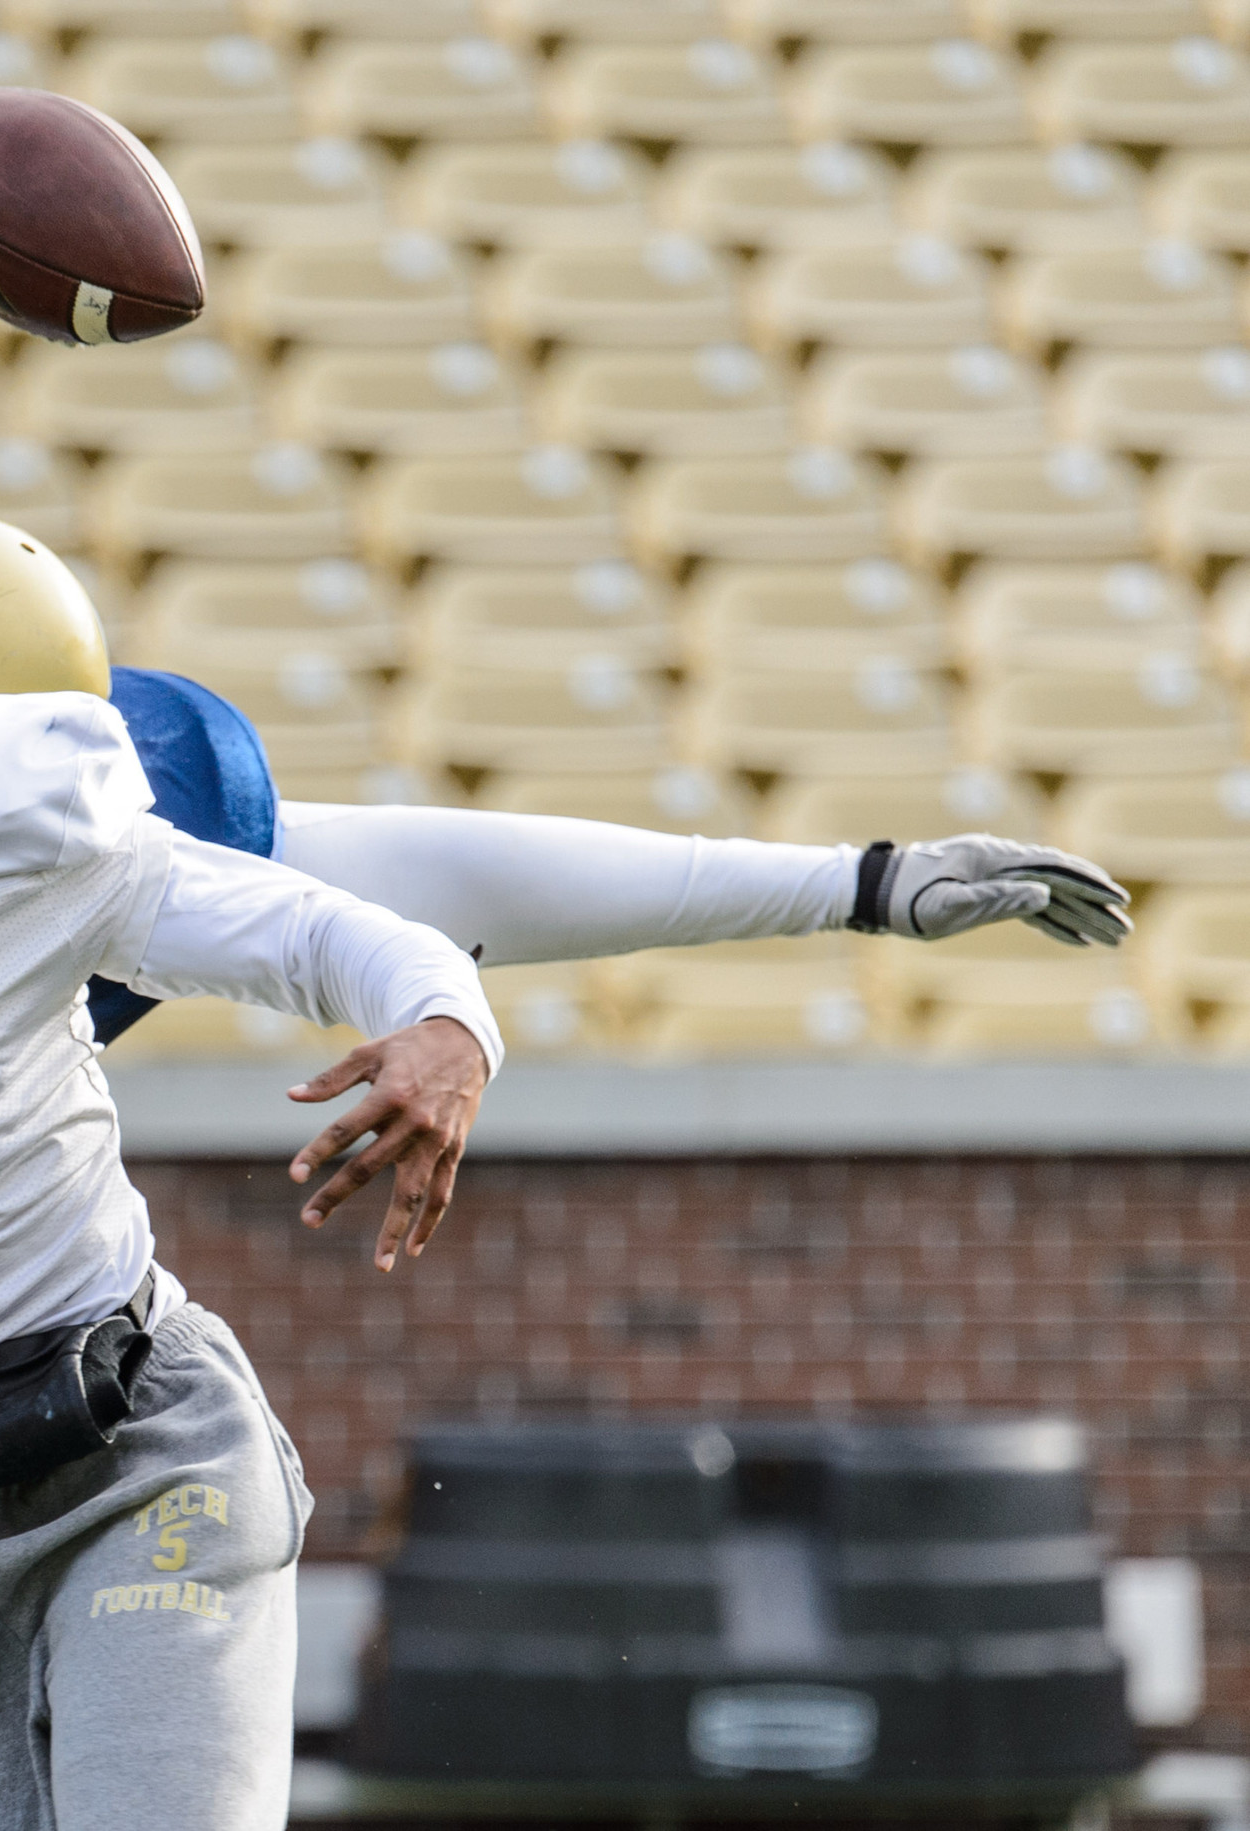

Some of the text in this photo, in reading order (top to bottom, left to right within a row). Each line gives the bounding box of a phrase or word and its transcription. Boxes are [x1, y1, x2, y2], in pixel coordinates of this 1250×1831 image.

[133, 1483, 230, 1536] TECH
[152, 1519, 191, 1571] 5
[89, 1581, 232, 1622] FOOTBALL
